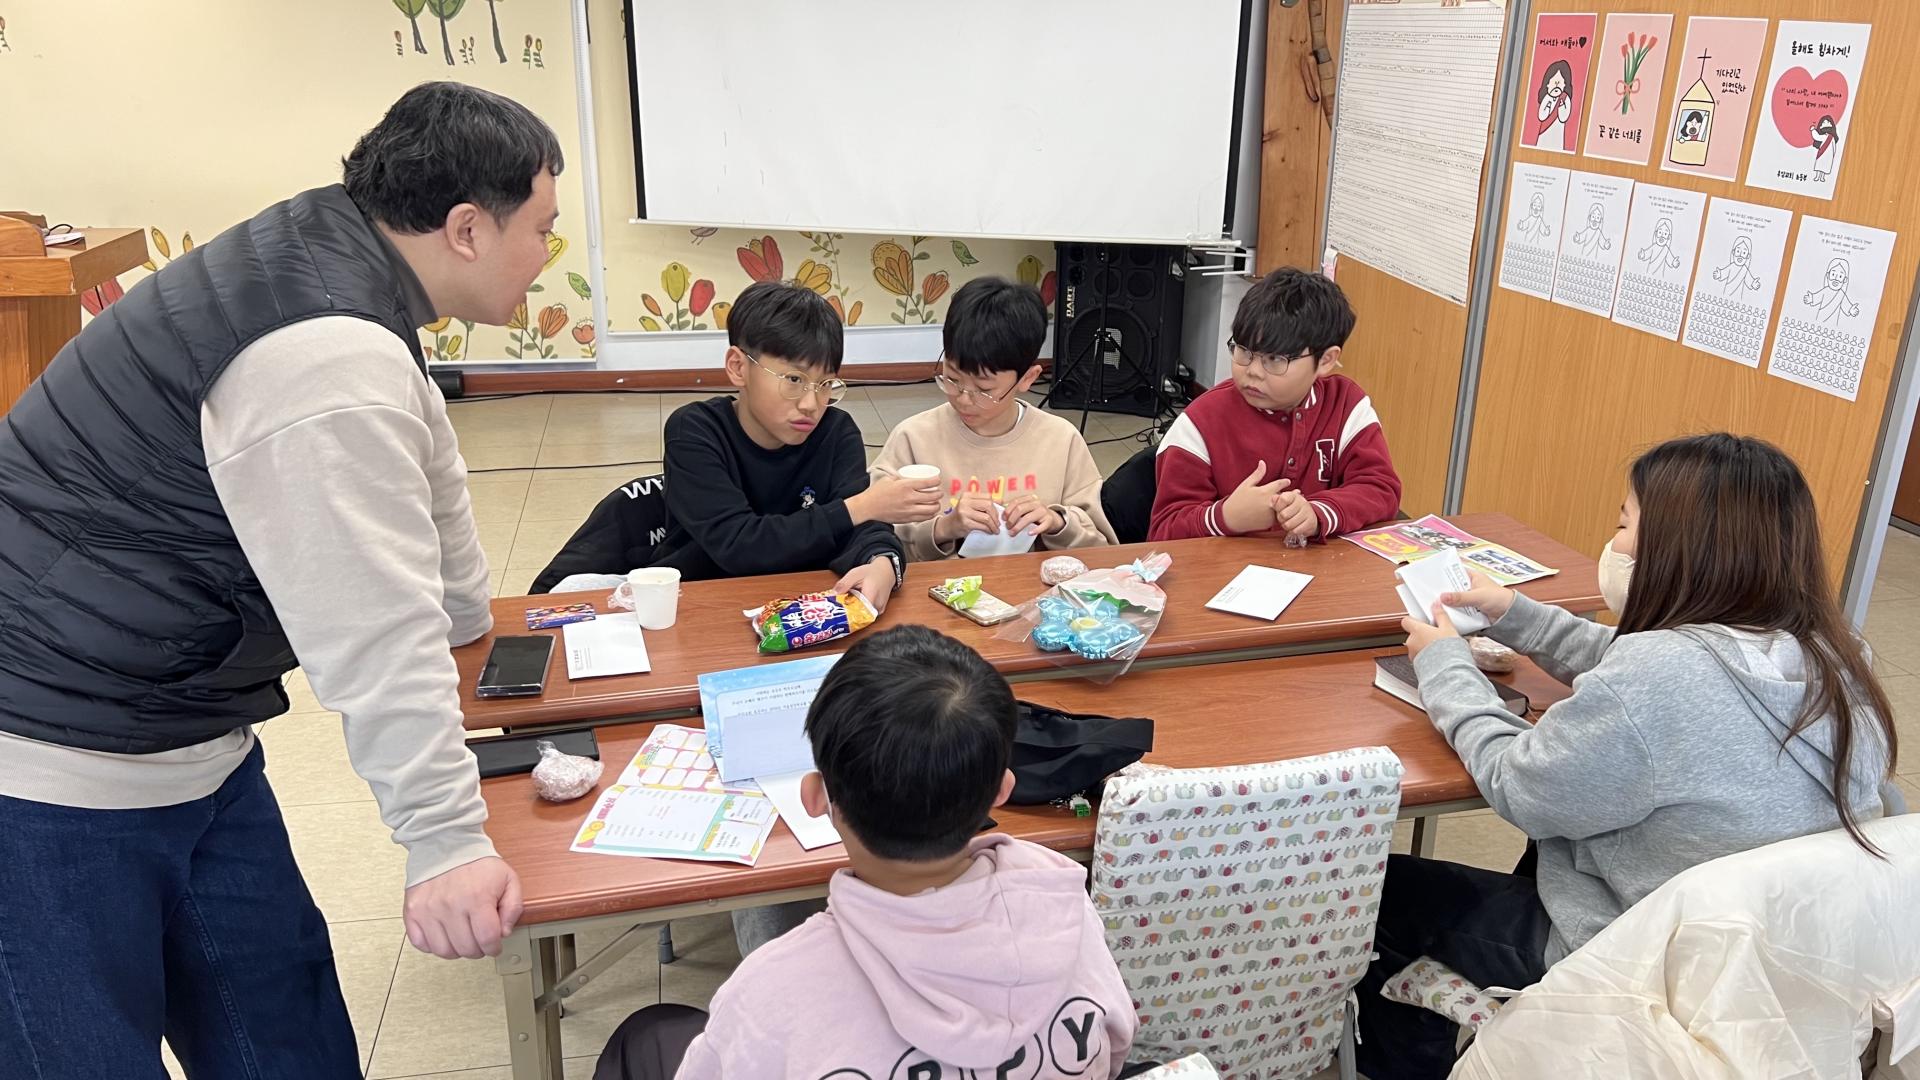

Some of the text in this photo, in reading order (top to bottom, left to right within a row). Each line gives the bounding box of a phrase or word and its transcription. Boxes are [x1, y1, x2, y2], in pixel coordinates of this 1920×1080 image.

[1540, 38, 1558, 47] 어서와
[1791, 41, 1851, 58] 올해도 힘차게!
[1716, 69, 1746, 94] 기다리고 있었단다
[1609, 127, 1620, 139] 같은
[1622, 129, 1641, 143] 너희를
[950, 474, 1037, 496] POWER
